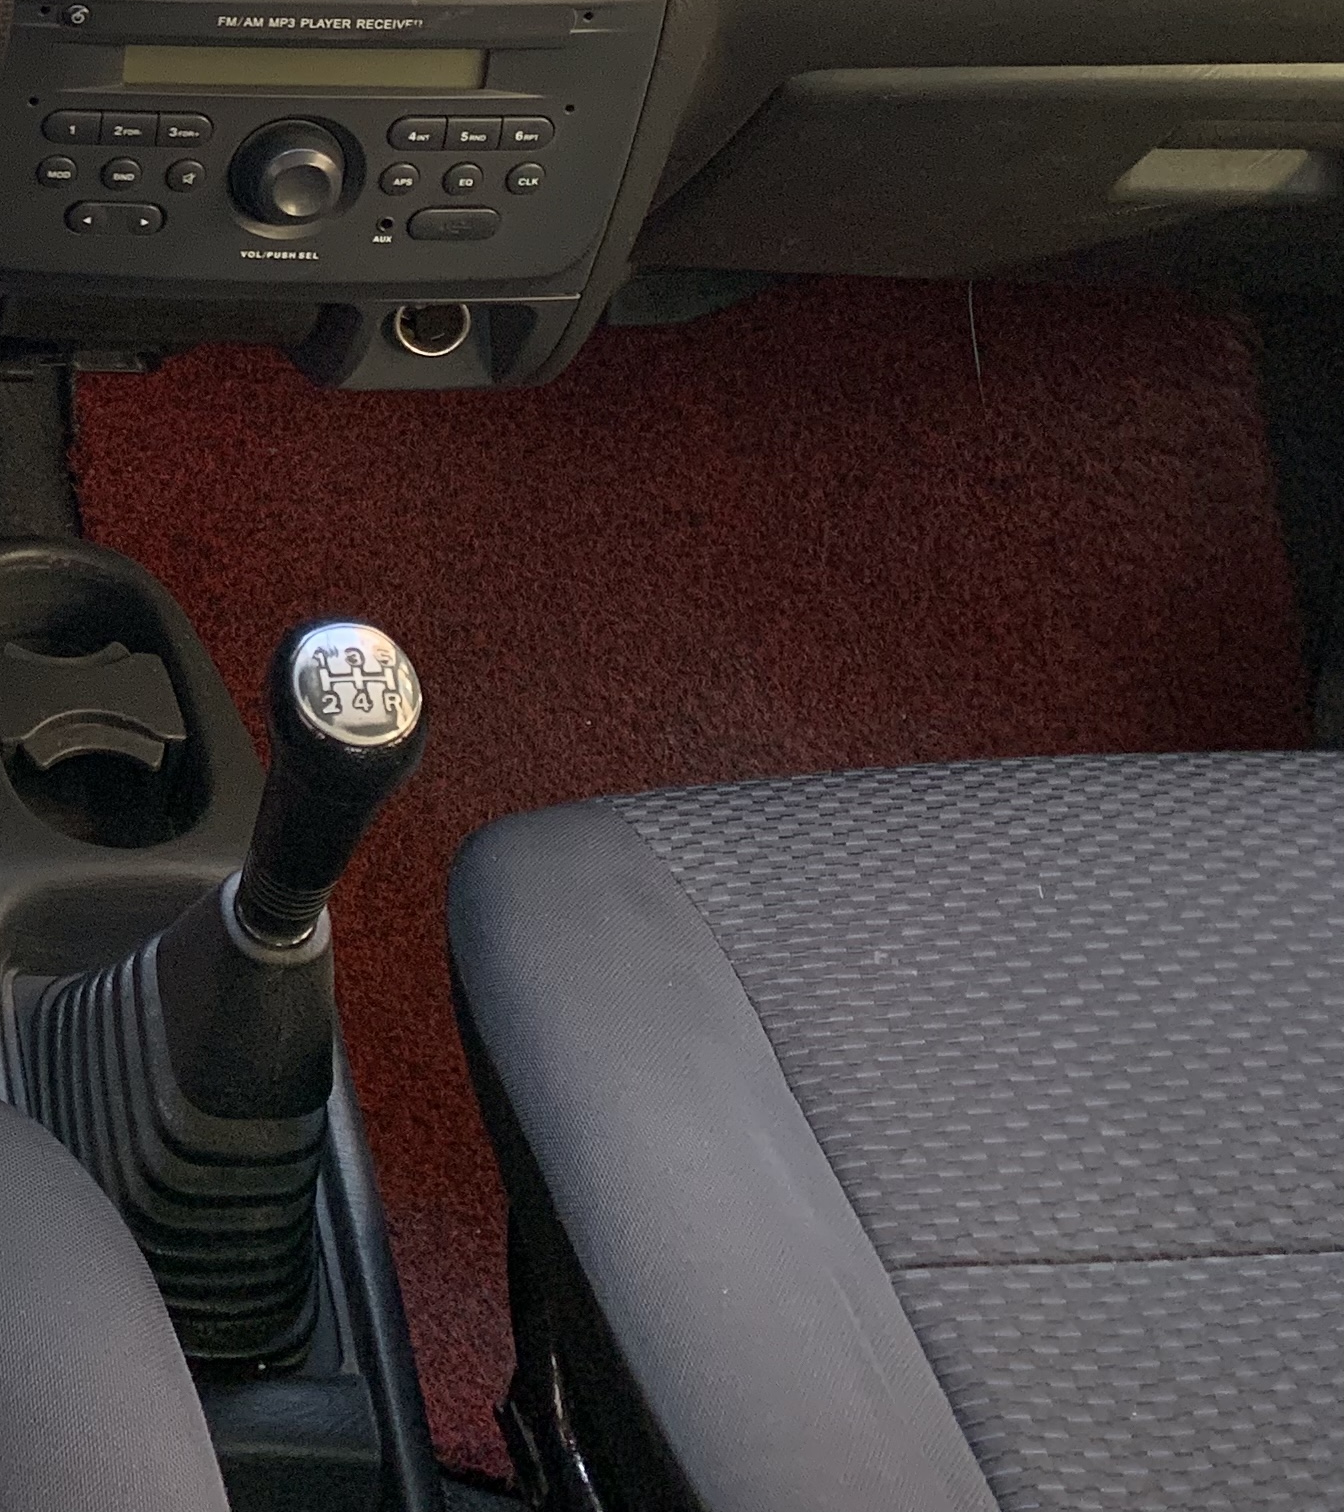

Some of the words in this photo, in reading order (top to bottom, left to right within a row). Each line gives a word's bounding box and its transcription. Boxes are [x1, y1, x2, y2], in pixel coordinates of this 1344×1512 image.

[217, 16, 264, 28] FM/AM
[268, 17, 296, 29] MP3
[300, 18, 351, 30] PLAYER
[69, 125, 76, 135] 1
[393, 177, 413, 186] APS
[459, 178, 474, 187] EQ
[518, 177, 539, 186] CLK
[372, 235, 392, 243] AUX
[298, 251, 319, 260] SEL
[344, 647, 365, 668] 3
[375, 647, 396, 668] 5
[322, 693, 342, 714] 2
[353, 691, 372, 711] 4
[384, 691, 402, 712] R
